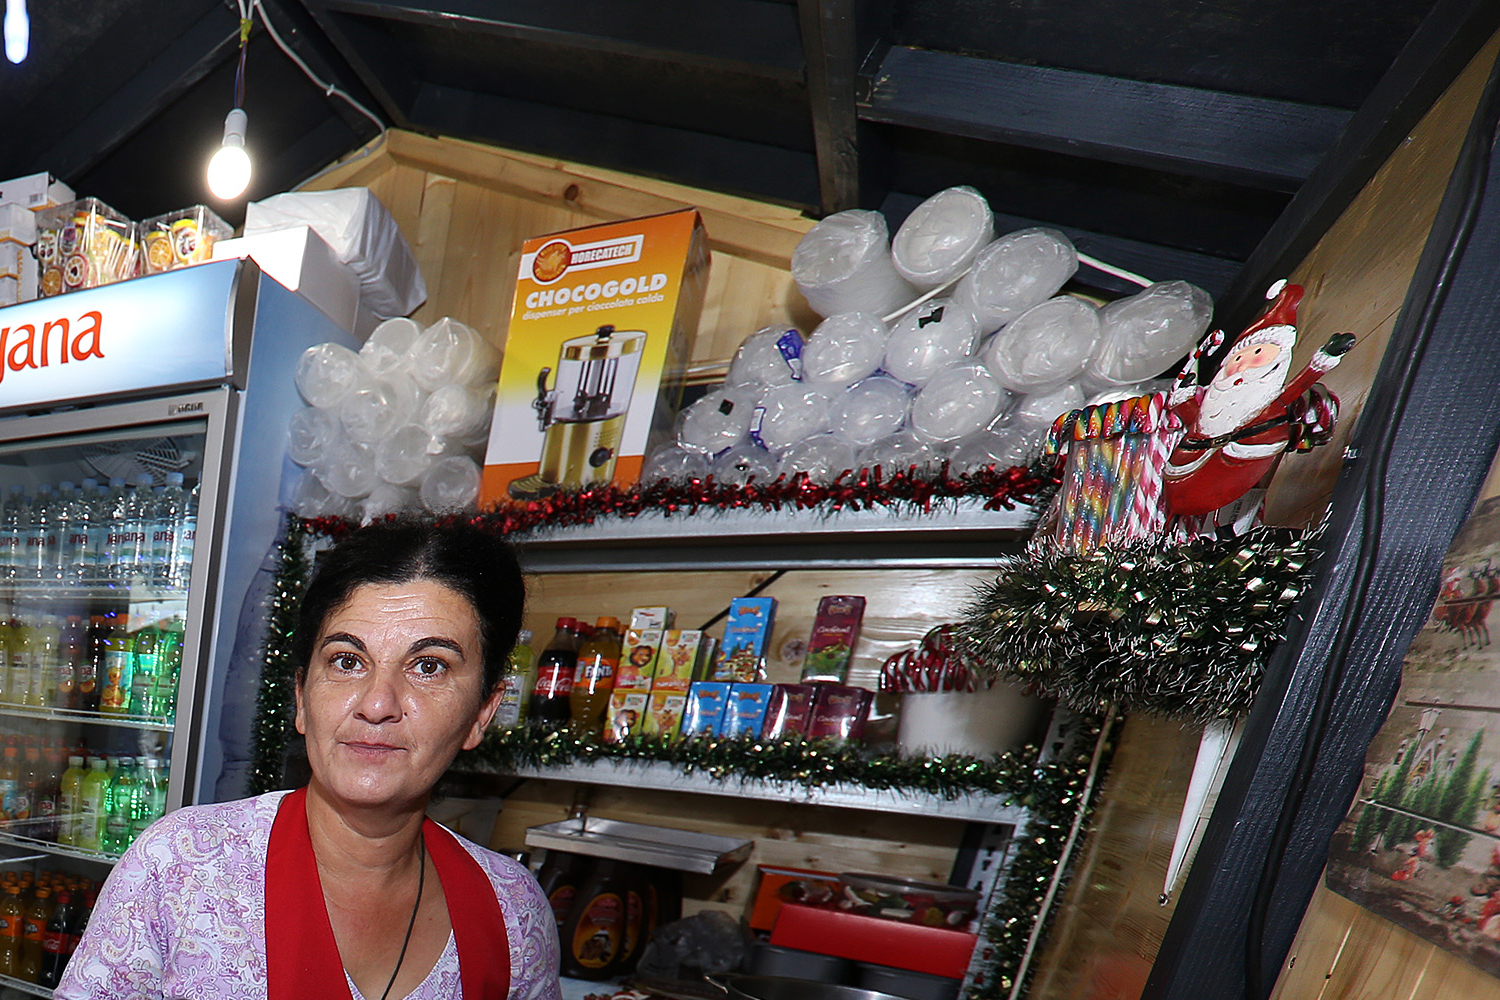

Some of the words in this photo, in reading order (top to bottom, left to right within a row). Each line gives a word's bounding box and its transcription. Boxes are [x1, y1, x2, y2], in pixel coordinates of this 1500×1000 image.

[571, 244, 633, 264] HORECATECH
[526, 273, 668, 309] CHOCOGOLD
[522, 307, 567, 320] dispenser
[568, 305, 585, 316] per
[586, 297, 634, 311] cioccolata
[636, 293, 664, 304] calda
